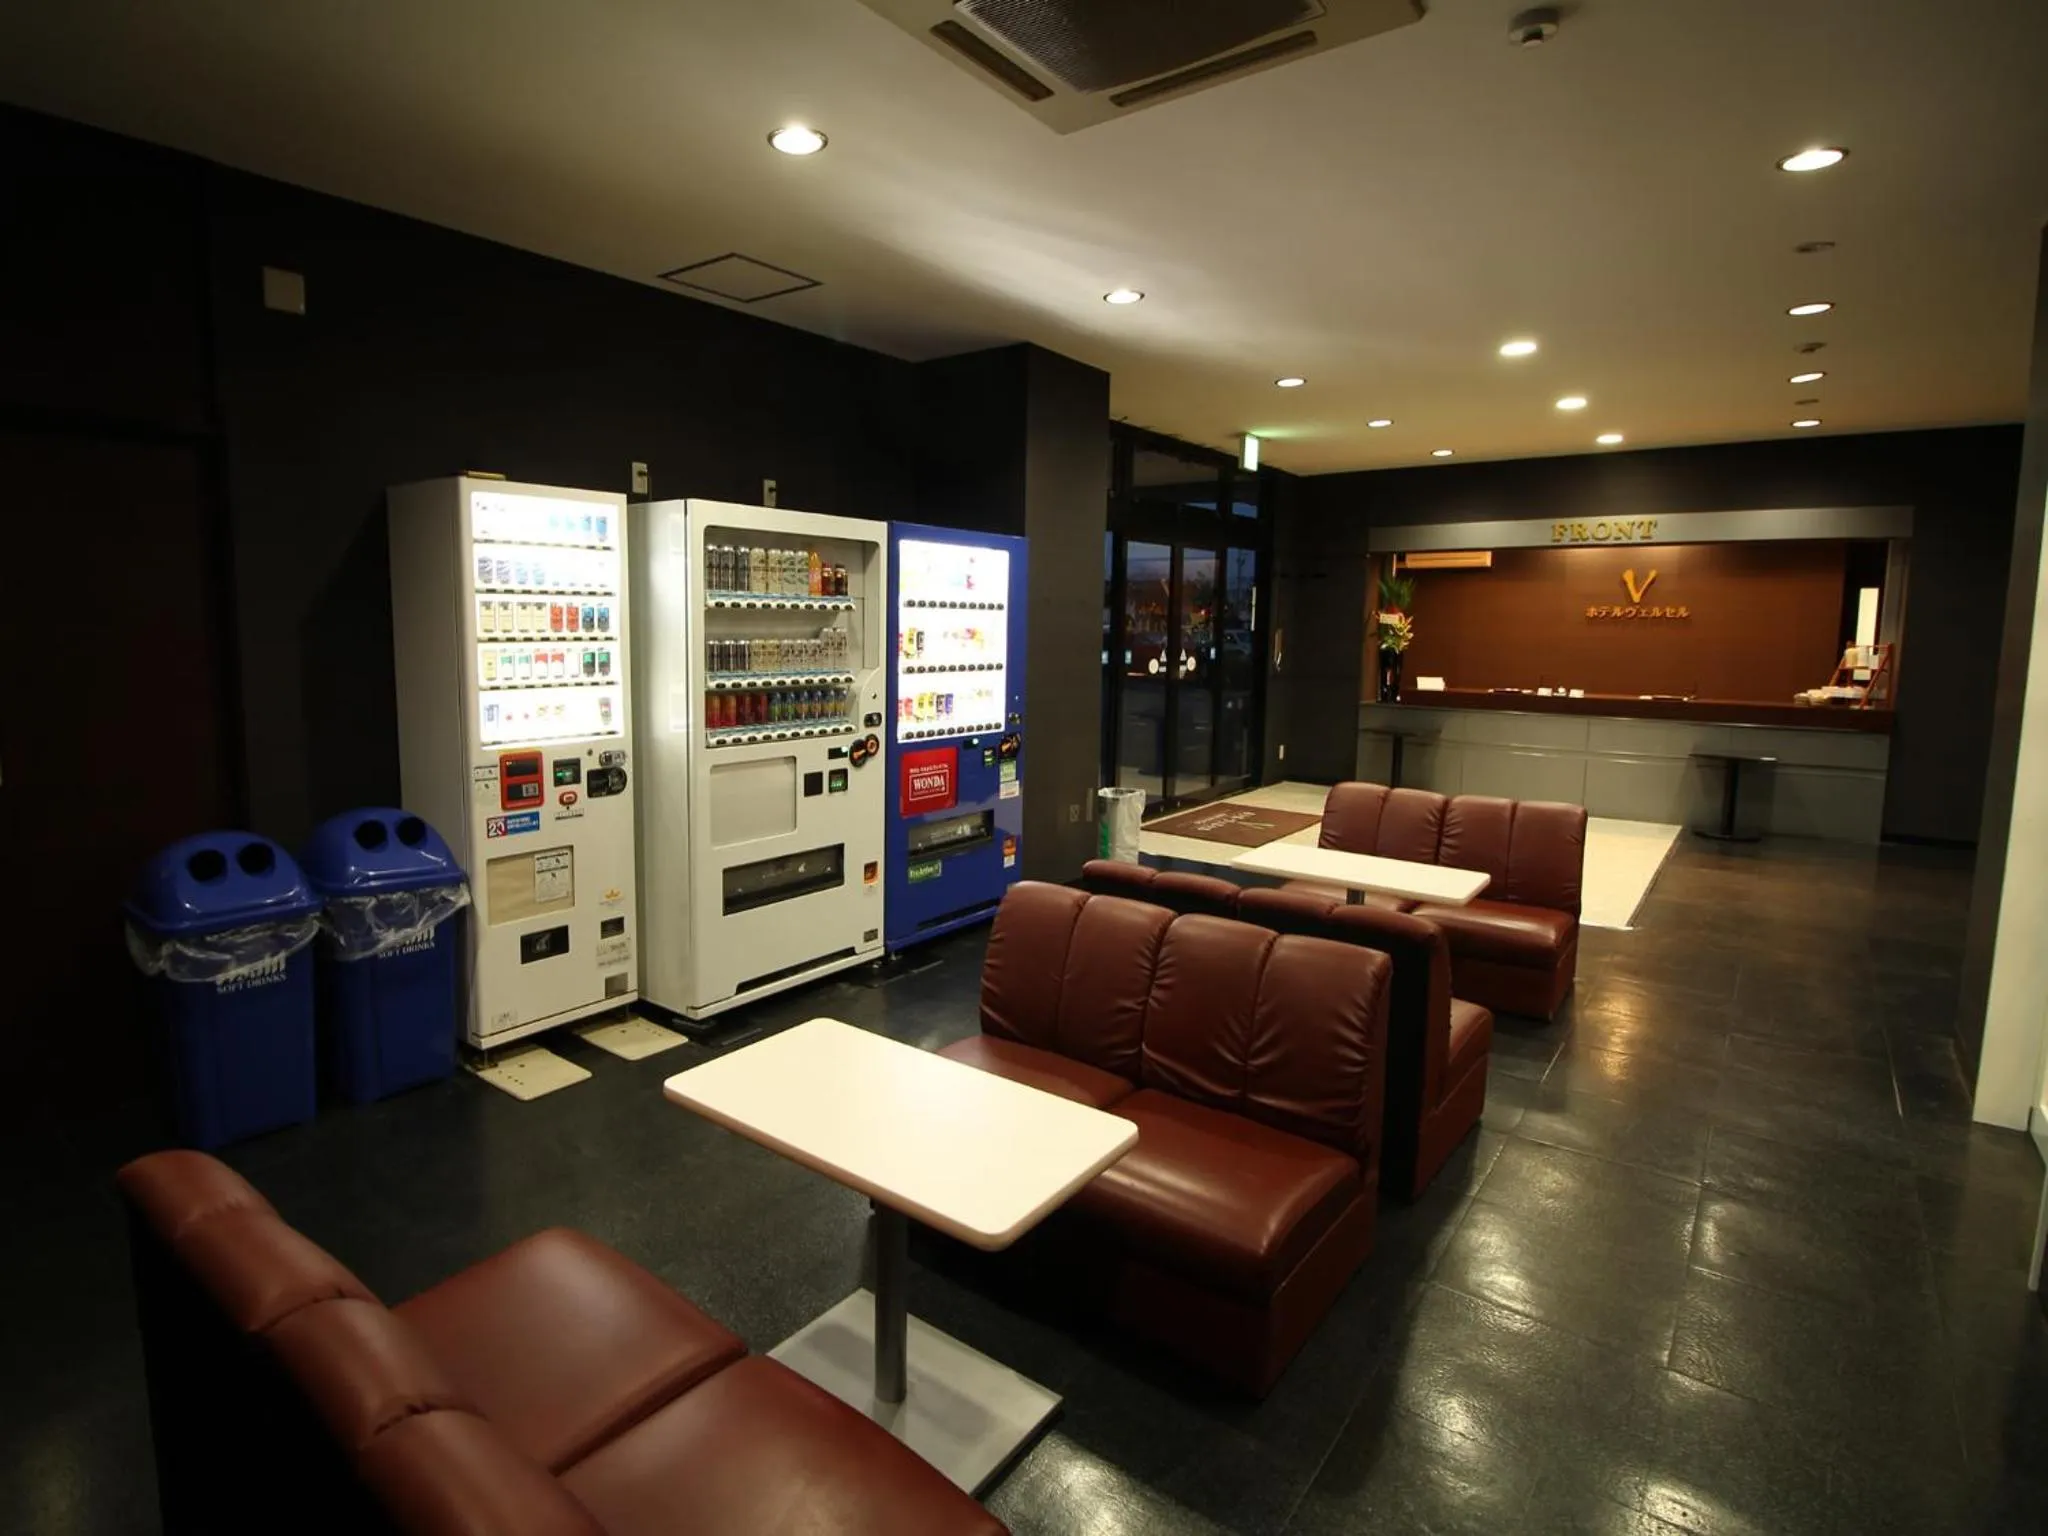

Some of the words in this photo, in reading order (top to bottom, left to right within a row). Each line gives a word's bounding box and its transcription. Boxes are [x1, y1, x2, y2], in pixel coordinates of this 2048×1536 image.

[1551, 519, 1658, 543] FRONT
[1622, 568, 1658, 603] V
[1585, 604, 1691, 619] ホテルヴェルセル
[913, 774, 945, 790] WONDA
[247, 972, 287, 989] DRINKS
